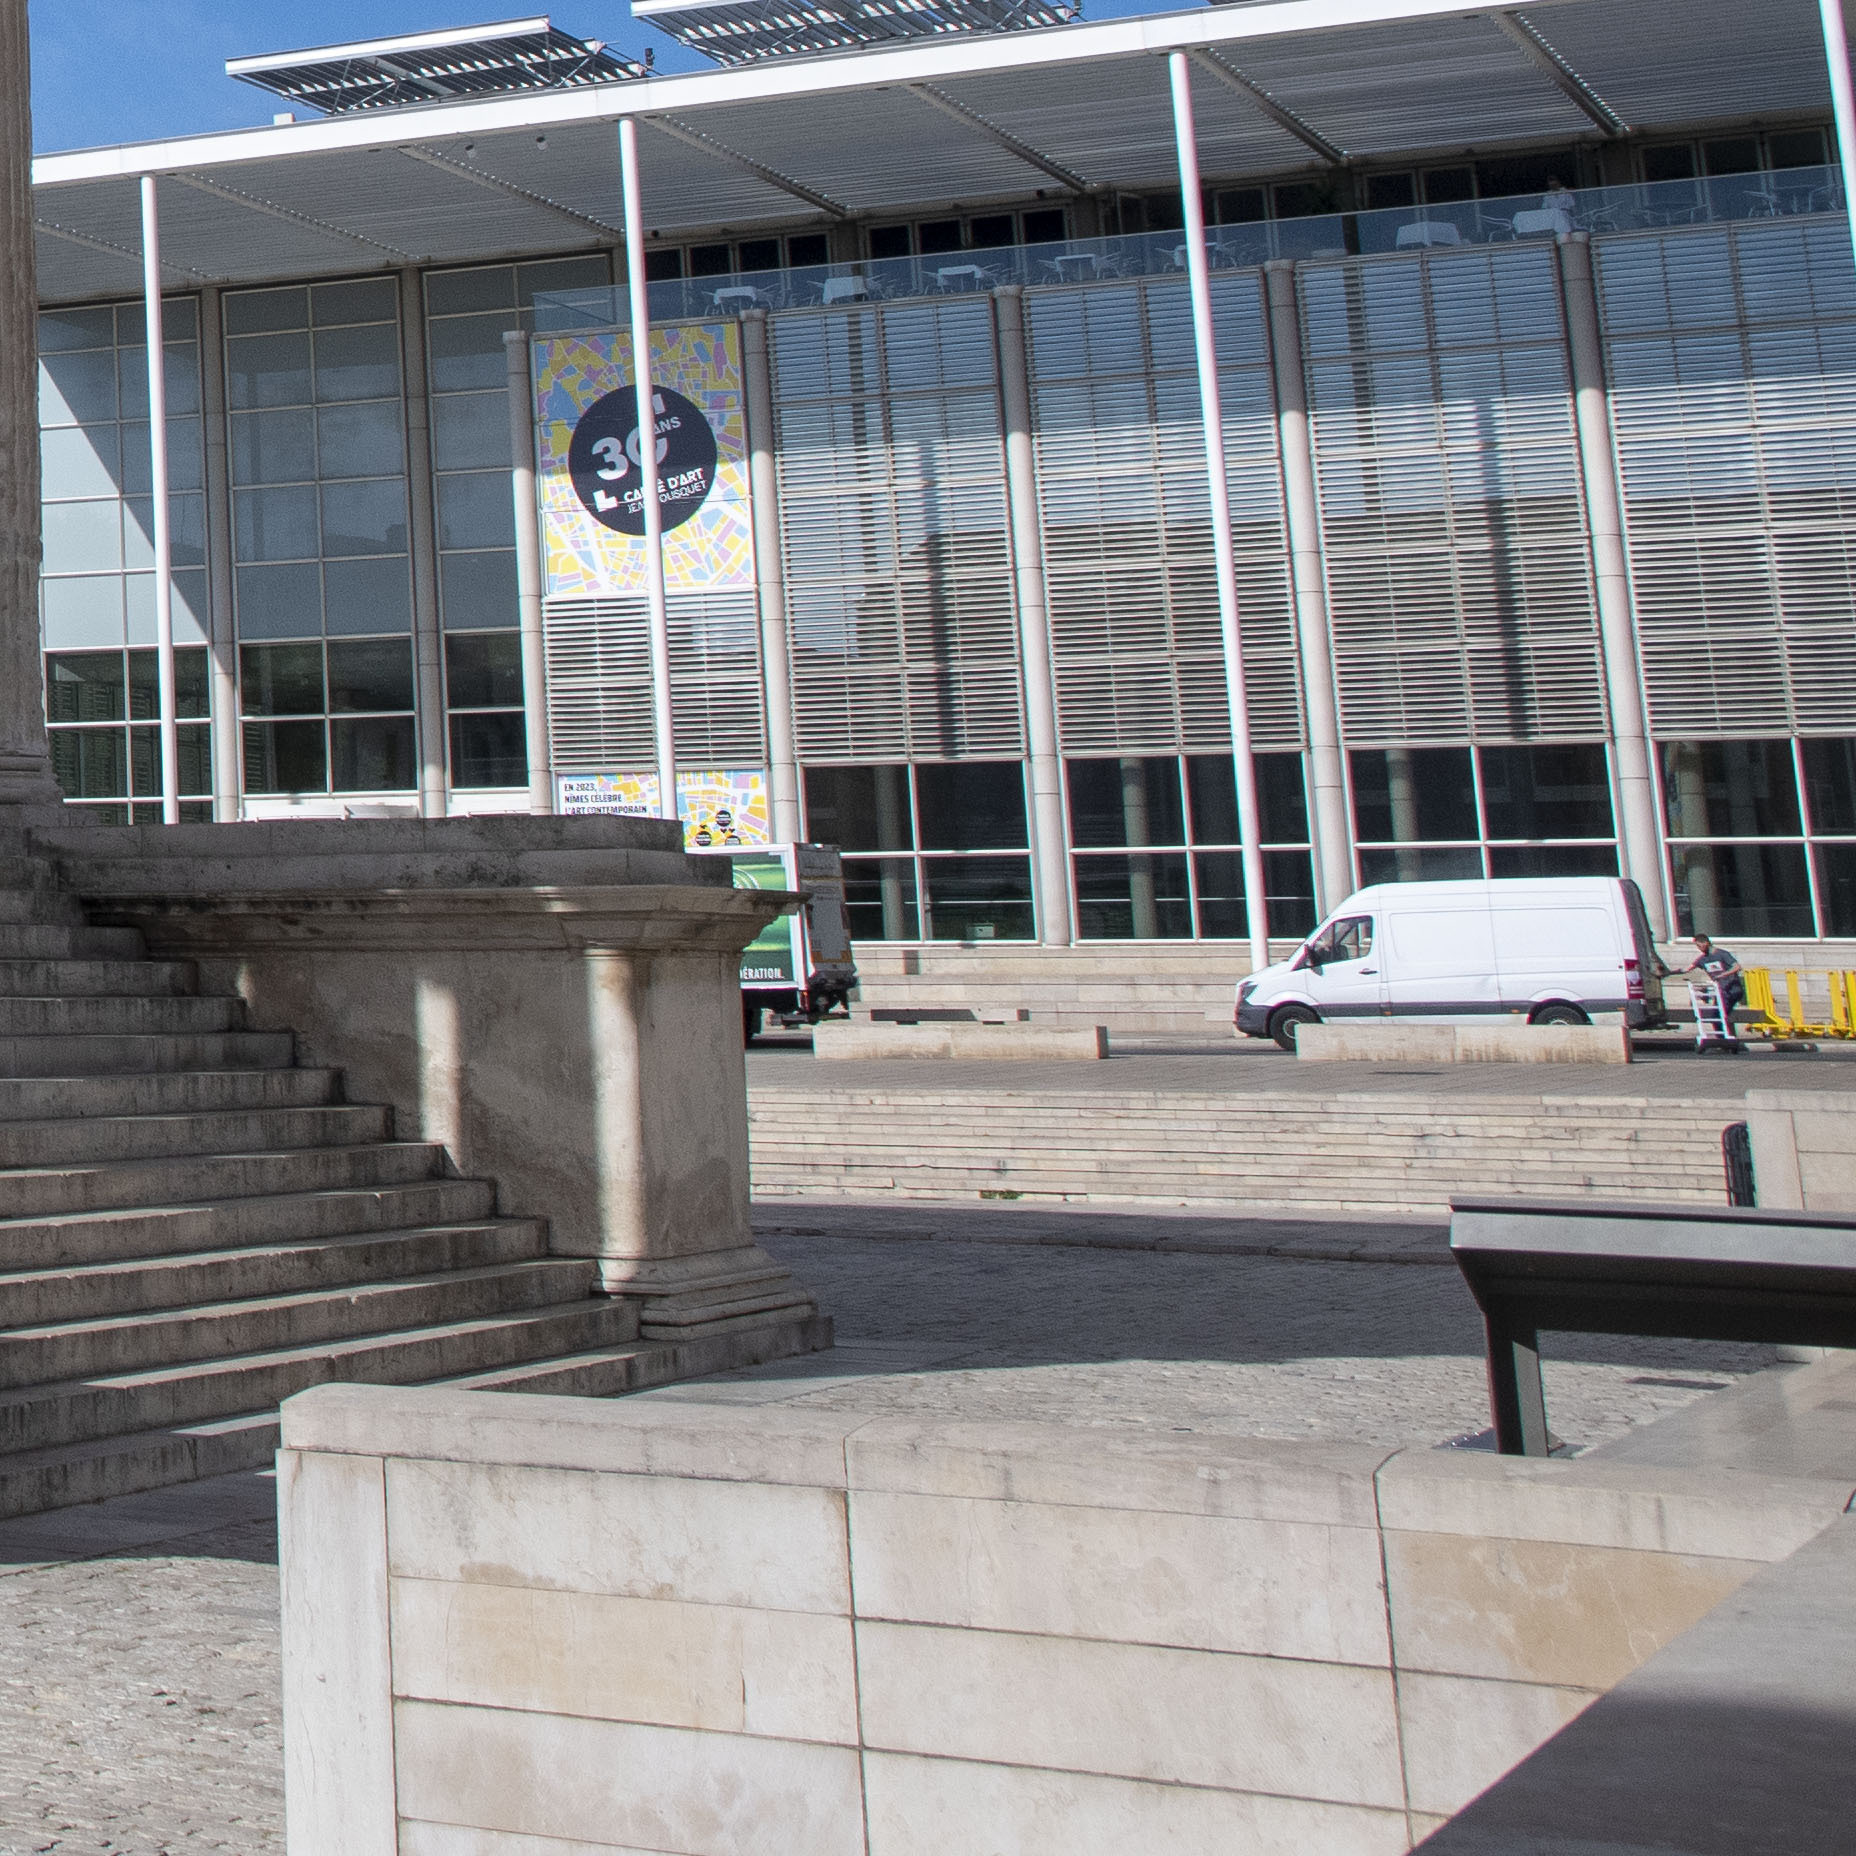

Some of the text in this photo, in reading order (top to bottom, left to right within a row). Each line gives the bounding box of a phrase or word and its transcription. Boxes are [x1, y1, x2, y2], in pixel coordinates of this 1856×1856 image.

[667, 467, 704, 490] D'ART
[659, 480, 707, 503] OUSQUET
[564, 782, 597, 793] EN 2023,
